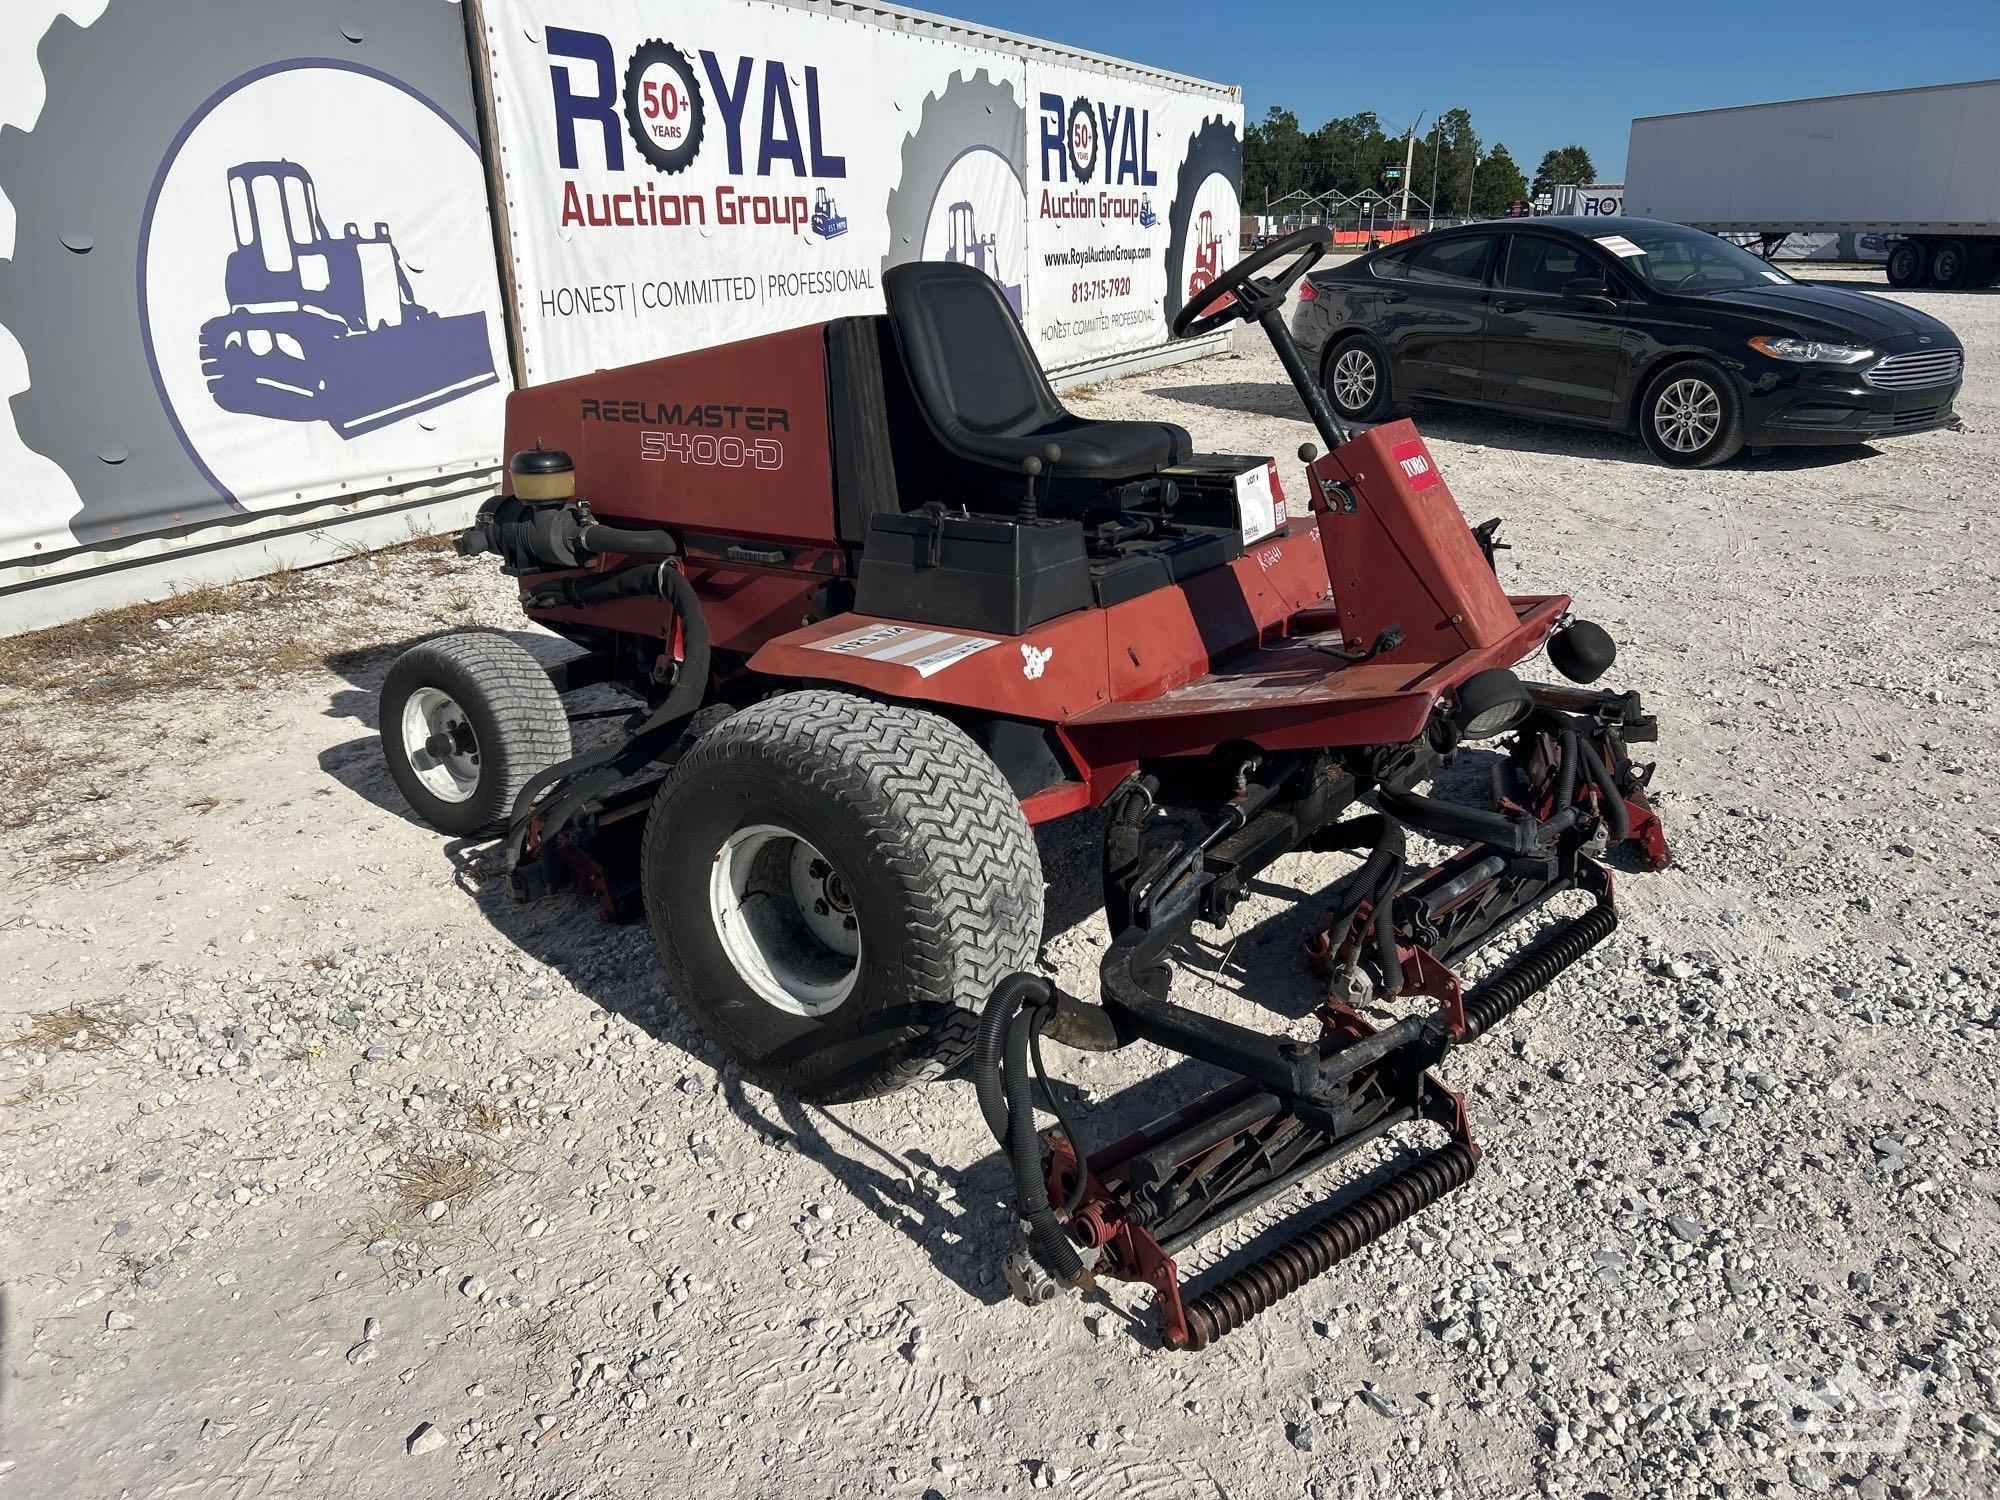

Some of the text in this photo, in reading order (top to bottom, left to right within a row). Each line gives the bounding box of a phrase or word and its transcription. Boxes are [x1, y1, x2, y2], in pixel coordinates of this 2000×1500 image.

[545, 26, 847, 179] ROYAL
[643, 81, 689, 120] 50+
[652, 125, 682, 139] YEARS
[1039, 91, 1158, 187] ROYAL
[1074, 123, 1093, 149] 50+
[1076, 151, 1089, 161] YEARS
[561, 180, 809, 235] Auction Group
[1040, 188, 1139, 225] Auction Group
[1044, 244, 1151, 270] www.RoyalAuctionGroup.com
[539, 268, 875, 318] HONEST COMMITTED PROFESSIONAL
[1071, 276, 1131, 303] 813-715-7920
[581, 398, 791, 433] REELMASTER
[640, 430, 784, 471] 5400-D
[1399, 454, 1429, 478] TORO
